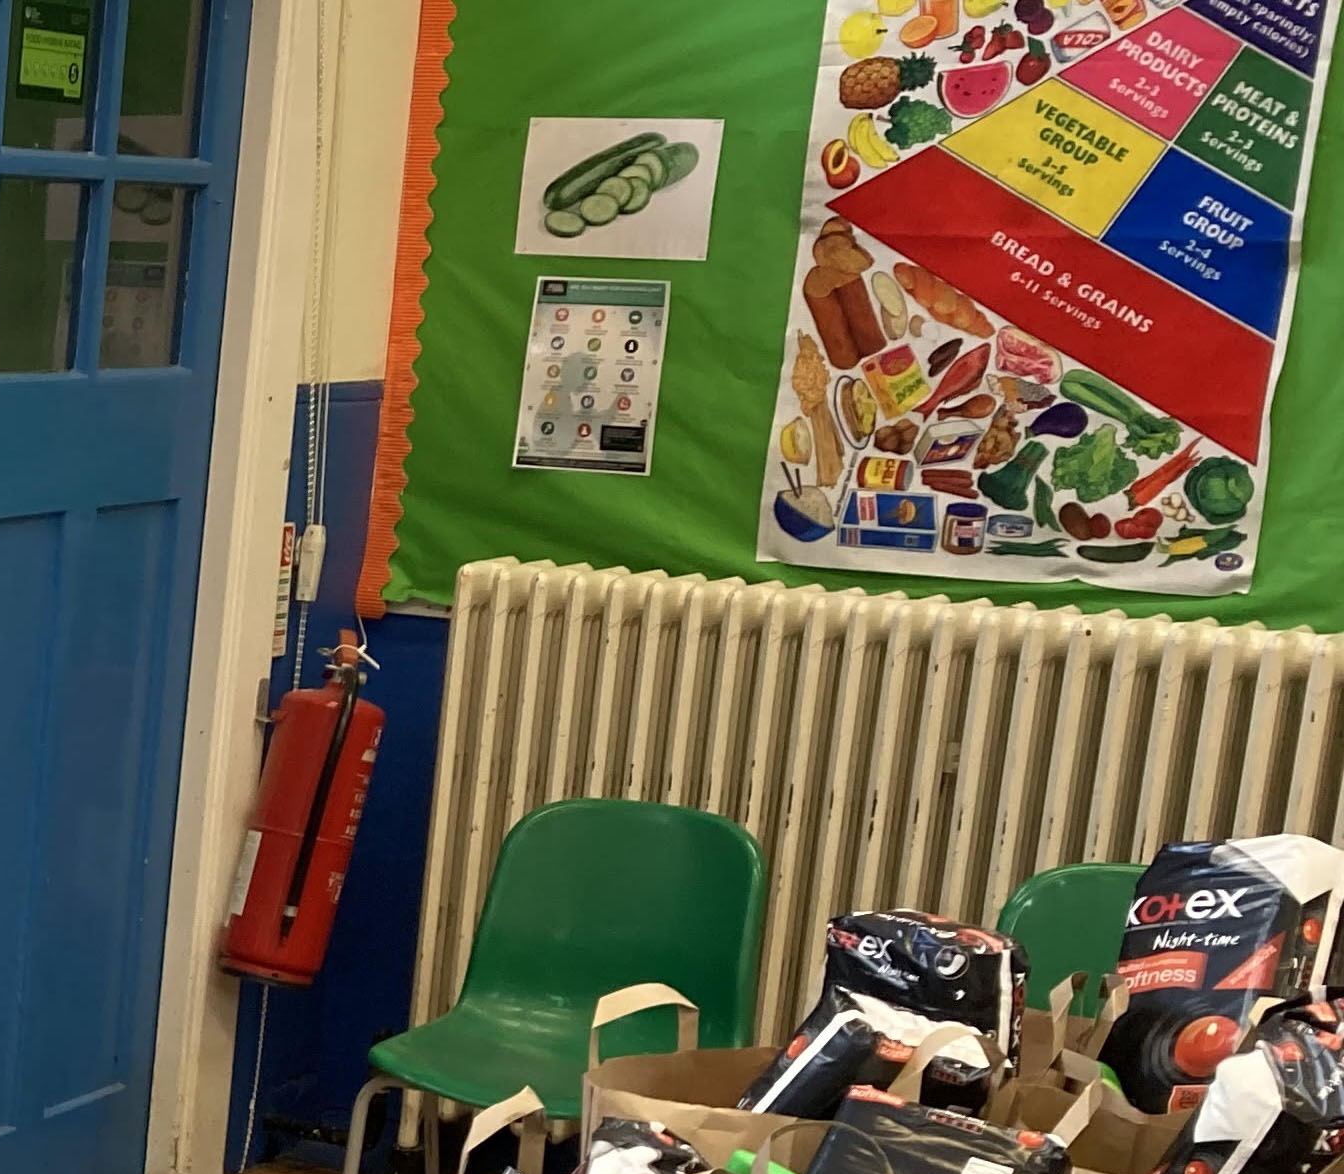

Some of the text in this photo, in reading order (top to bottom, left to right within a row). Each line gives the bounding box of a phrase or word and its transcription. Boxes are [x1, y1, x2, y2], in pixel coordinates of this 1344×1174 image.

[1062, 30, 1105, 47] COLA
[1146, 31, 1204, 69] DAIRY
[1252, 21, 1310, 58] calories)
[1118, 38, 1208, 98] PRODUCTS
[1134, 77, 1160, 96] 2-3
[1109, 78, 1170, 120] Servings
[1232, 81, 1300, 127] MEAT &
[1034, 99, 1130, 162] VEGETABLE
[1212, 93, 1299, 150] PROTEINS
[1228, 130, 1254, 150] 2-3
[1039, 127, 1099, 166] GROUP
[1041, 155, 1067, 175] 3-5
[1200, 130, 1263, 173] Servings
[1017, 157, 1075, 198] Servings
[1182, 211, 1245, 250] GROUP
[1197, 195, 1254, 233] FRUIT
[1158, 240, 1222, 281] Servings
[1185, 240, 1212, 260] 2-4
[990, 231, 1154, 334] BREAD & GRAINS
[1010, 271, 1102, 330] 6-11 Servings
[1152, 928, 1241, 951] Night-time
